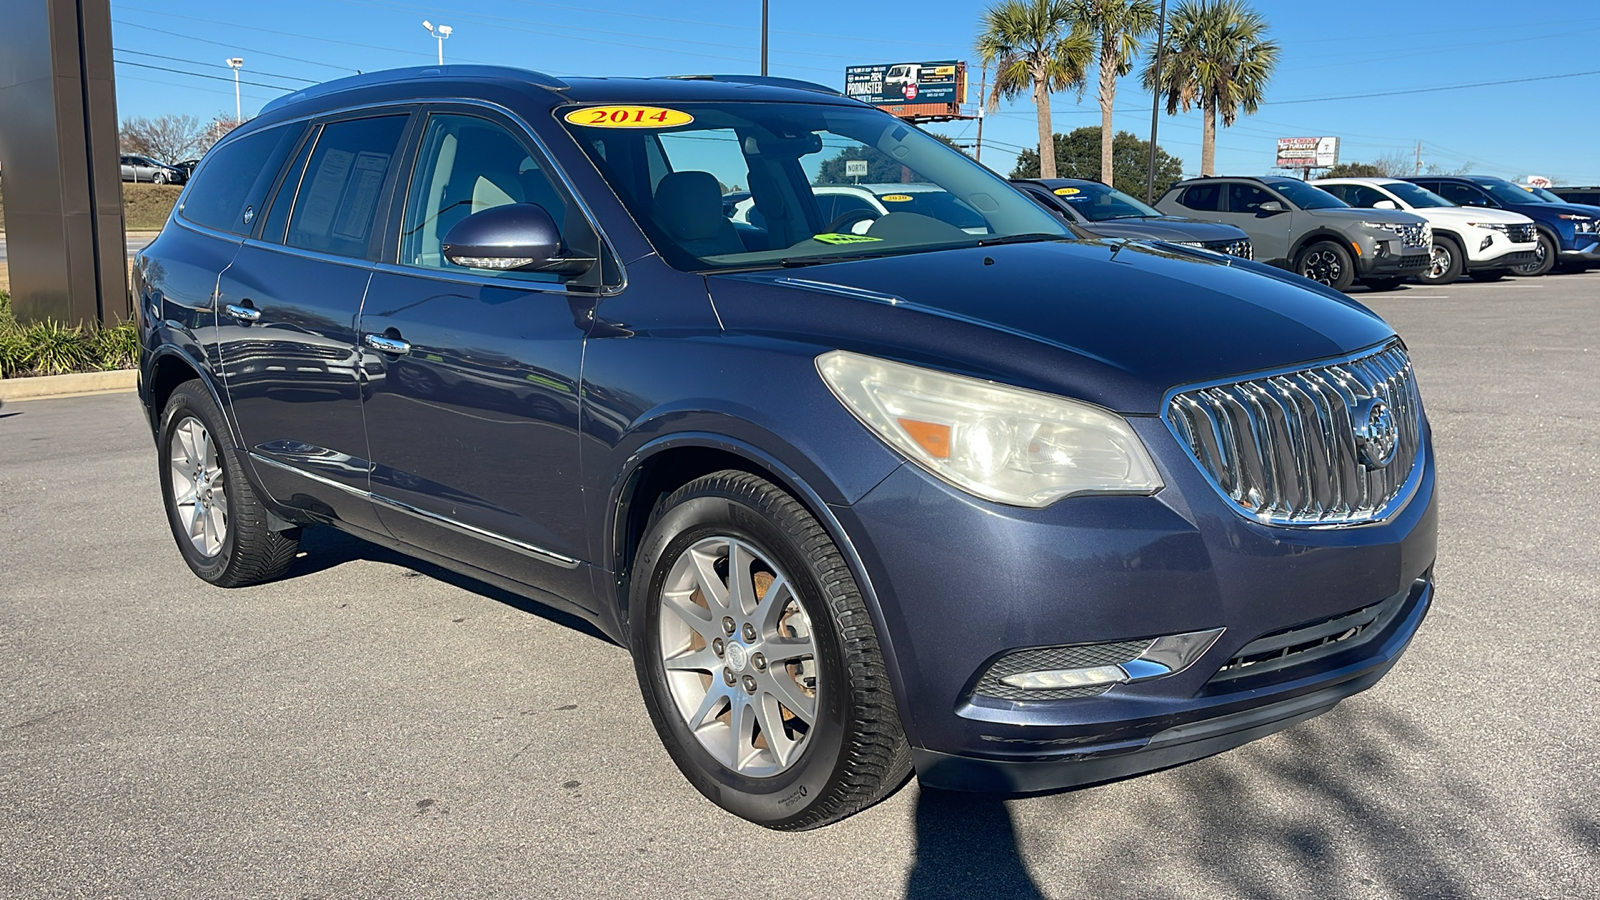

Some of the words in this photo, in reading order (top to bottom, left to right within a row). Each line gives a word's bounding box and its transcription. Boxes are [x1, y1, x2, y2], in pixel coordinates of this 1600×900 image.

[870, 72, 882, 82] 2024
[847, 81, 882, 95] PROMASTER
[589, 110, 668, 124] 2014
[847, 164, 866, 172] NORTH
